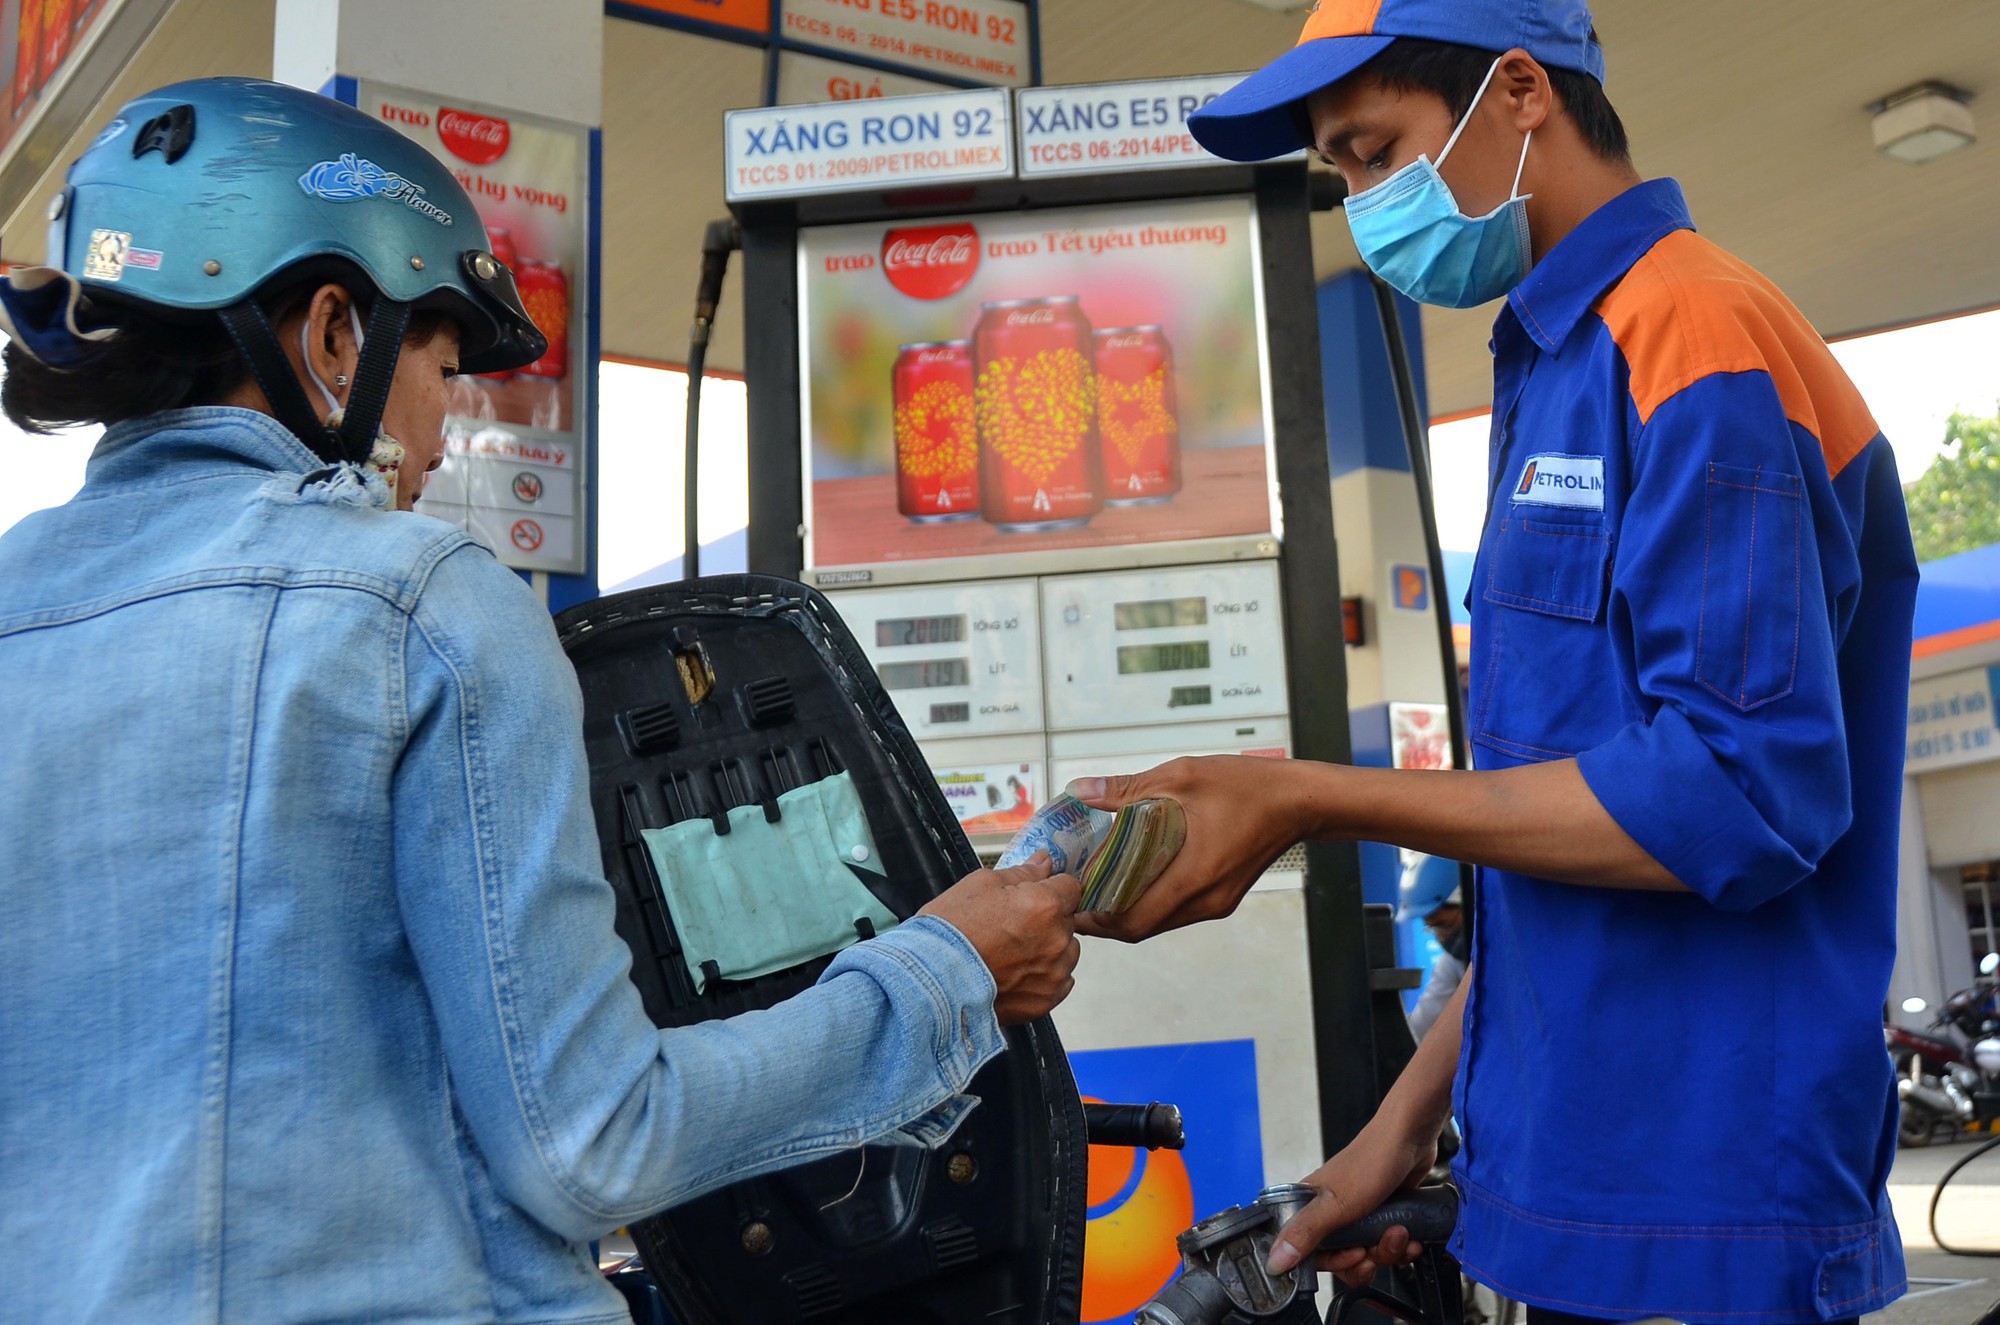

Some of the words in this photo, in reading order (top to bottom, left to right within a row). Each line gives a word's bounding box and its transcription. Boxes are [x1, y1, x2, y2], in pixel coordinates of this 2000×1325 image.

[785, 11, 832, 37] TCCS
[986, 15, 1016, 45] 92
[381, 103, 430, 127] trao
[1026, 98, 1120, 134] XĂNG
[1130, 98, 1169, 126] E5
[745, 118, 848, 157] XĂNG
[862, 111, 941, 147] RON
[953, 107, 993, 138] 92
[1030, 142, 1083, 163] TCCS
[1088, 134, 1204, 158] 06:2014/PE
[737, 164, 790, 186] TCCS
[382, 172, 453, 226] Flower
[477, 174, 508, 201] hy
[514, 186, 568, 214] vọng
[824, 253, 875, 273] trao
[988, 239, 1037, 258] trao
[1041, 227, 1084, 254] Tết
[1088, 228, 1134, 254] yêu
[1139, 224, 1228, 248] thương
